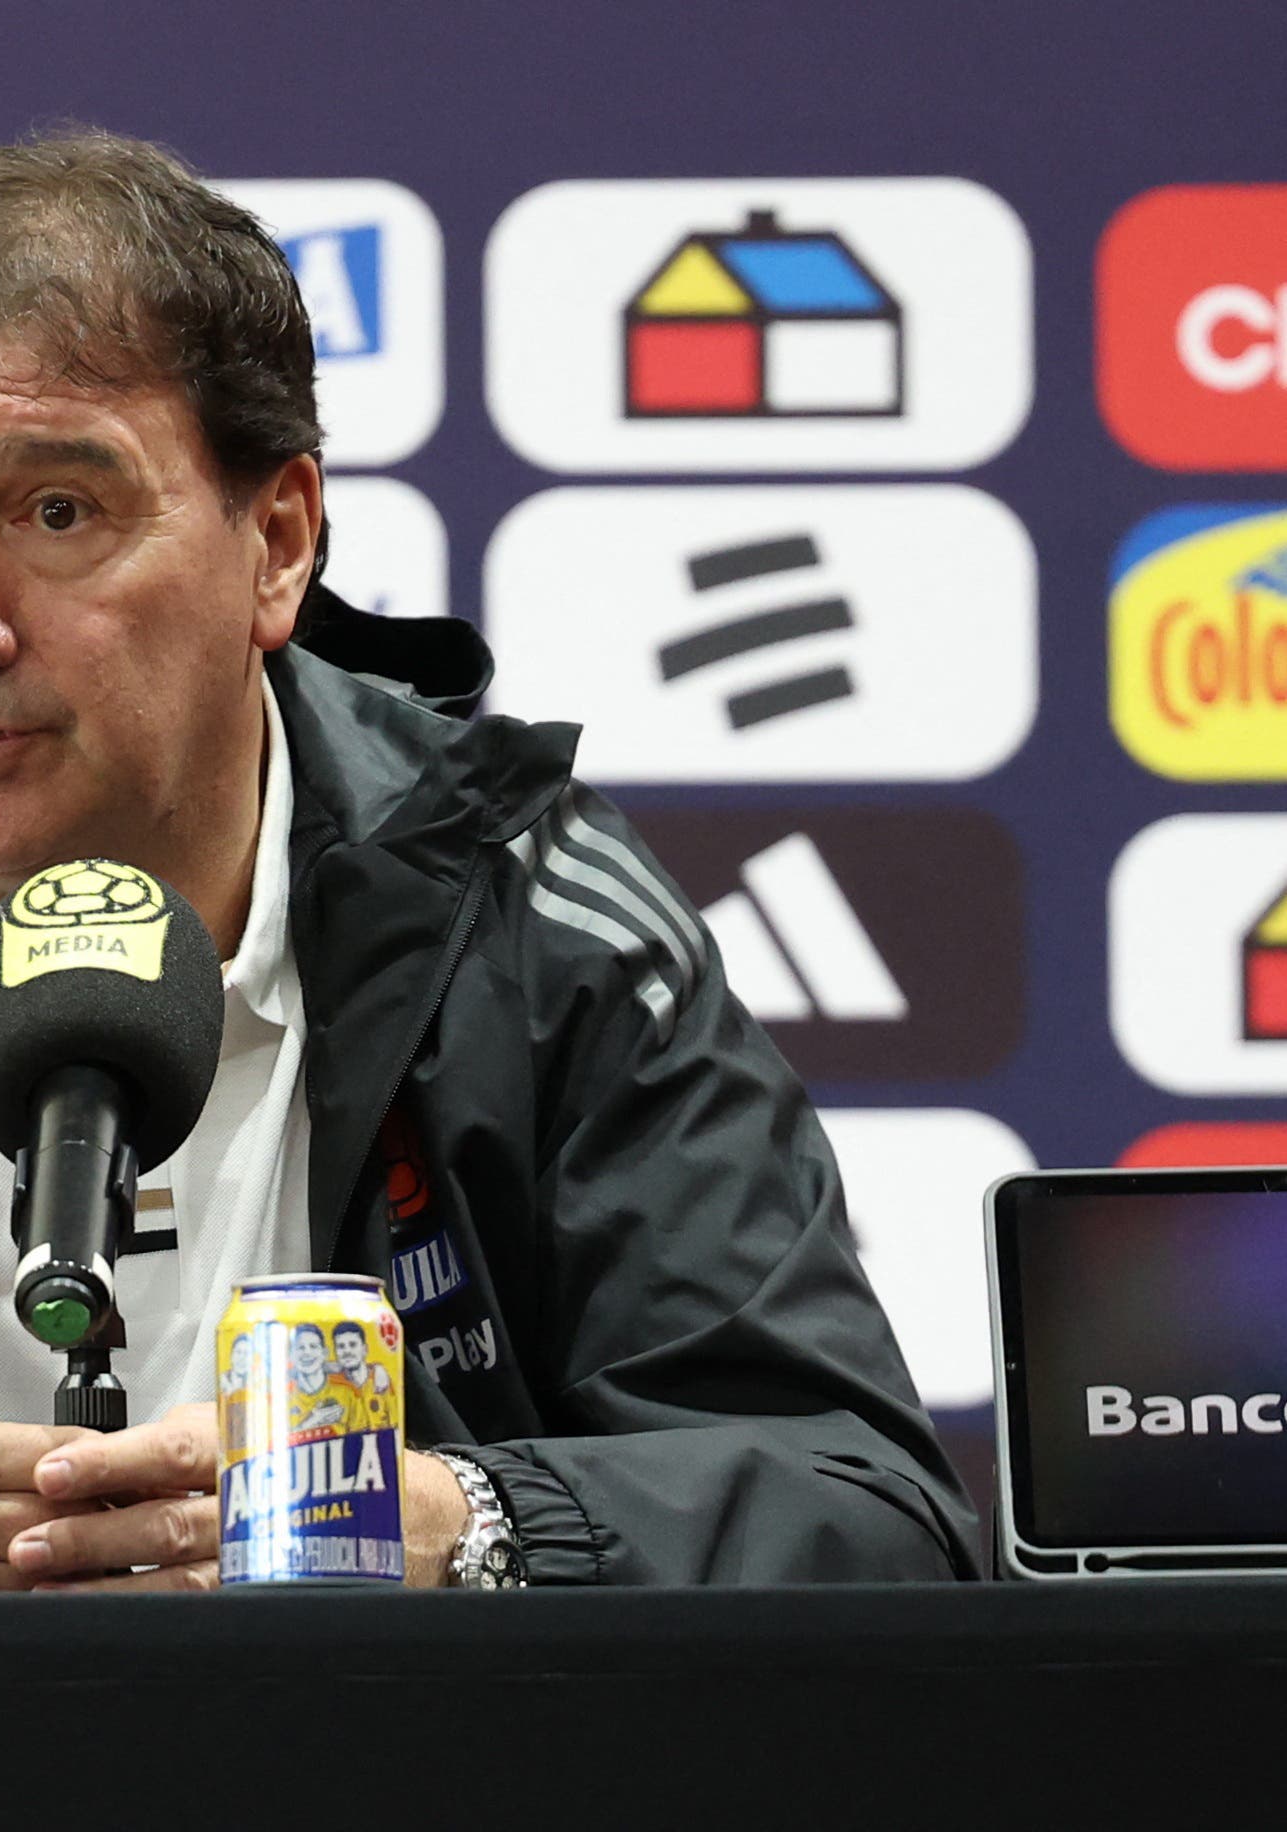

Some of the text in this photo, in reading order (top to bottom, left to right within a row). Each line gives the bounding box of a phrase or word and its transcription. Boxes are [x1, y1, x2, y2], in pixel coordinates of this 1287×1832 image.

[28, 934, 129, 963] MEDIA
[418, 1317, 497, 1384] Play
[1086, 1385, 1287, 1436] Banc
